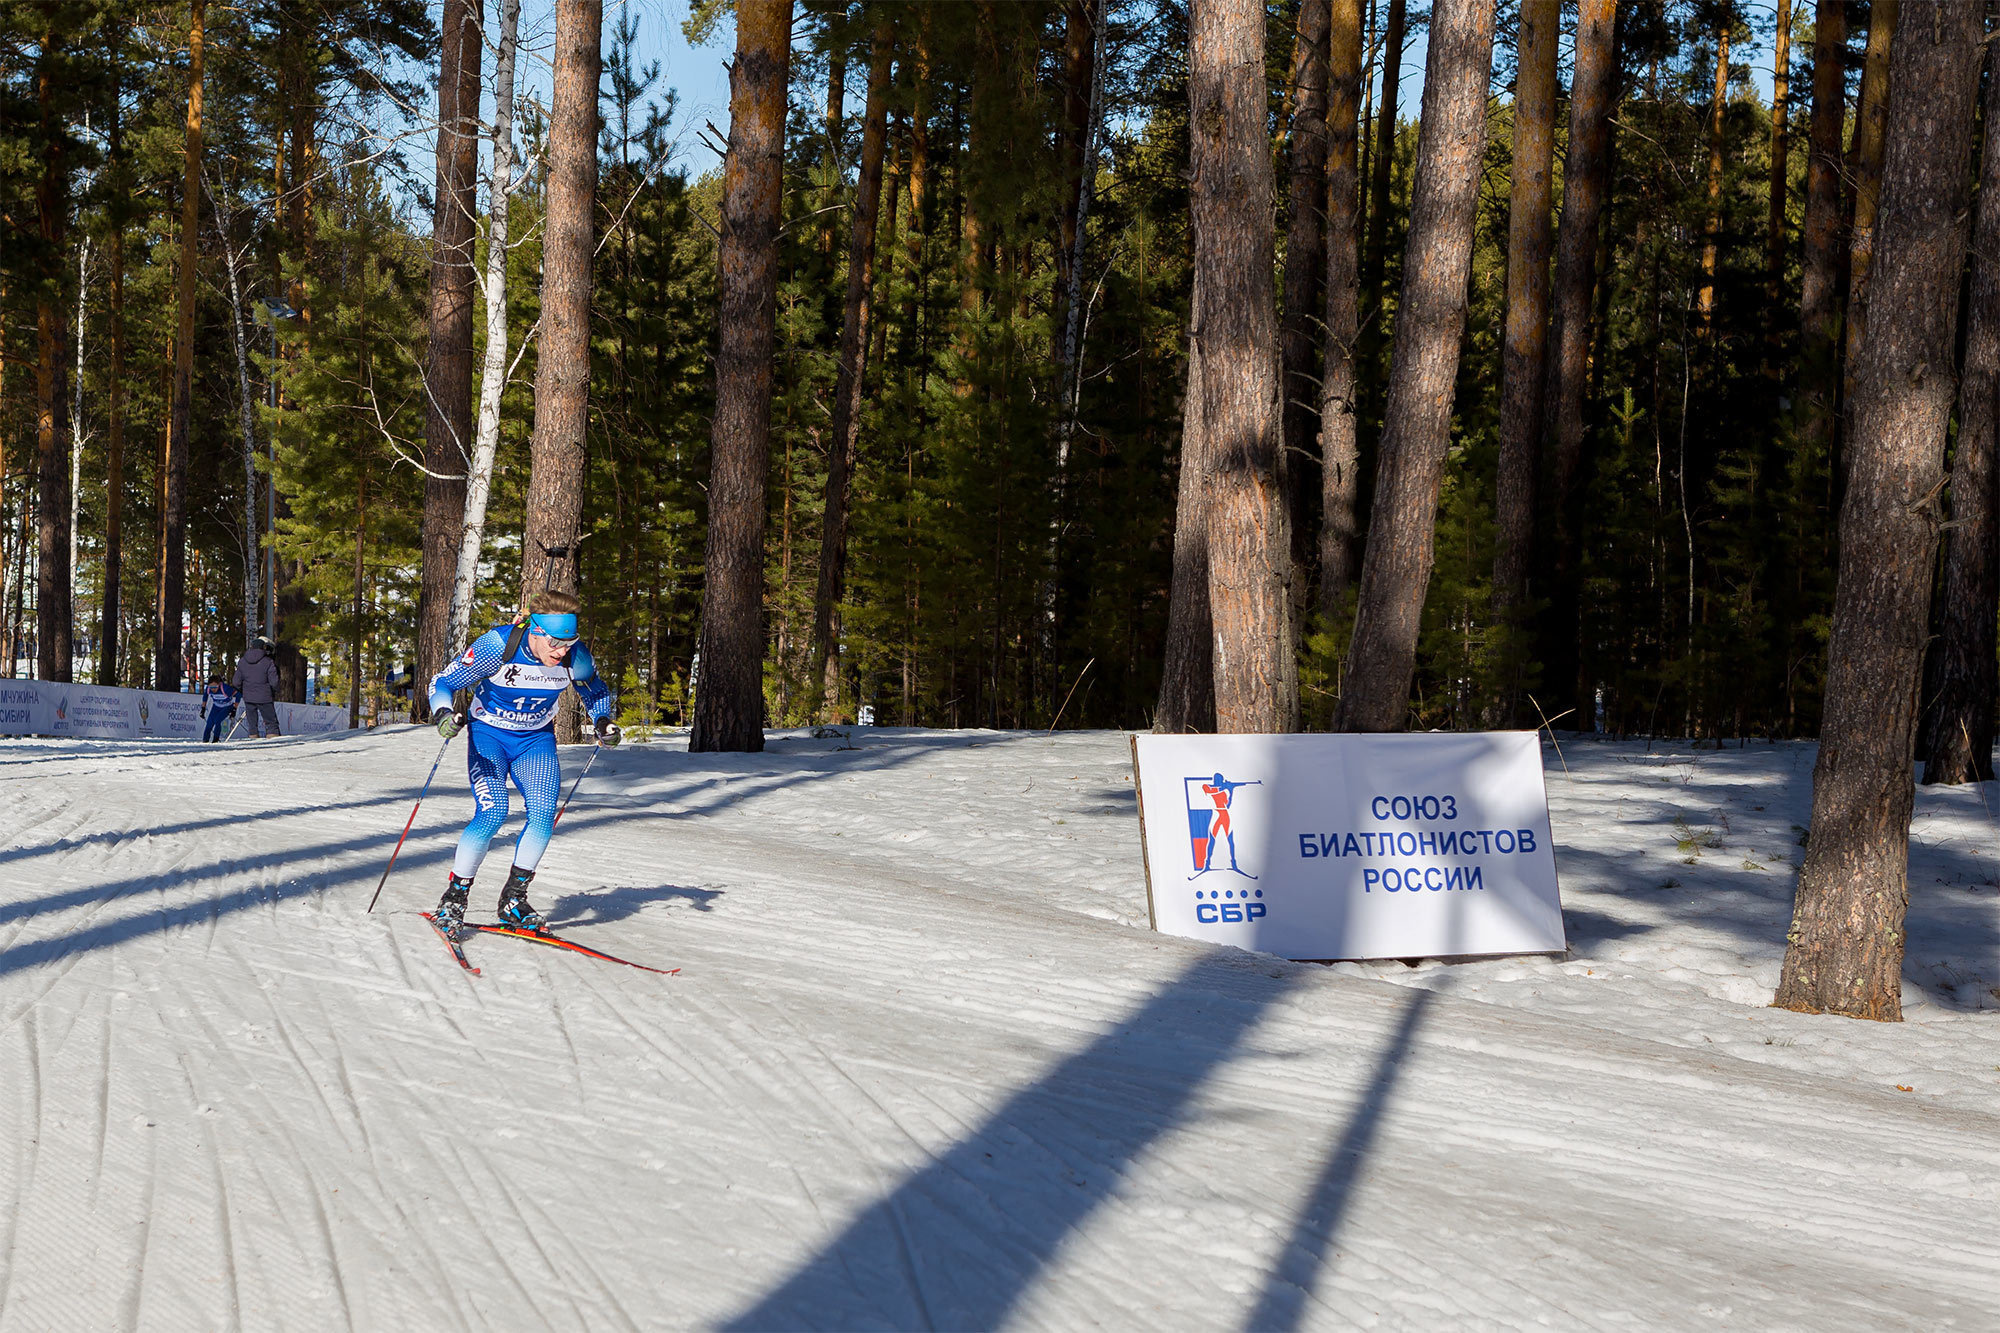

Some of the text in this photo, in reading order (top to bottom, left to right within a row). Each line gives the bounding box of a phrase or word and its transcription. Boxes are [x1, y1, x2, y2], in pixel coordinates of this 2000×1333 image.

[524, 675, 568, 683] VisitTyumen
[0, 690, 39, 705] МЧУЖИНА
[511, 697, 547, 710] 17
[0, 709, 31, 723] СИБИРИ
[1371, 795, 1457, 820] СОЮЗ
[1299, 829, 1537, 858] БИАТЛОНИСТОВ
[1364, 866, 1483, 893] РОССИИ
[1196, 903, 1267, 924] СБР
